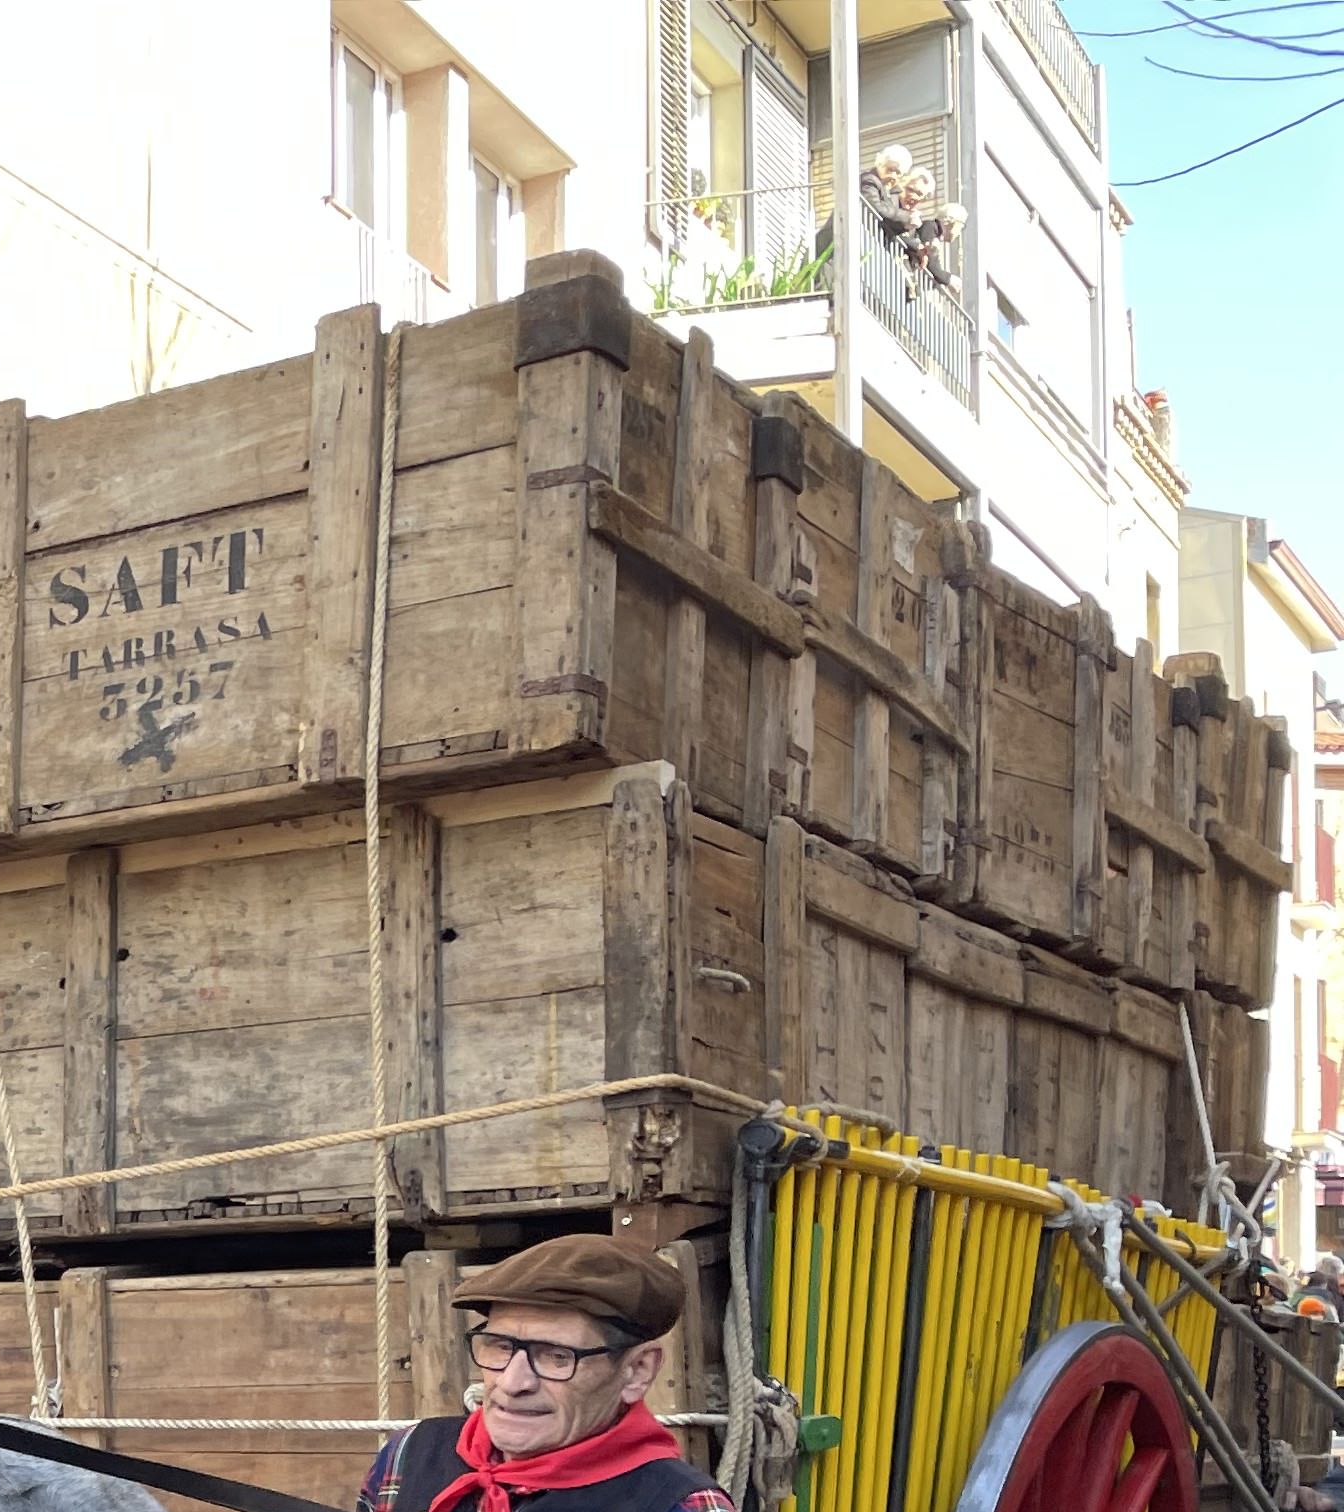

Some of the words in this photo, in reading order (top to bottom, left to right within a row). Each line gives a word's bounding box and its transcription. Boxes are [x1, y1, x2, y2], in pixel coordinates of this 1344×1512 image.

[49, 528, 264, 629] SAFT
[63, 611, 272, 682] TARRASA
[99, 660, 234, 722] 3257
